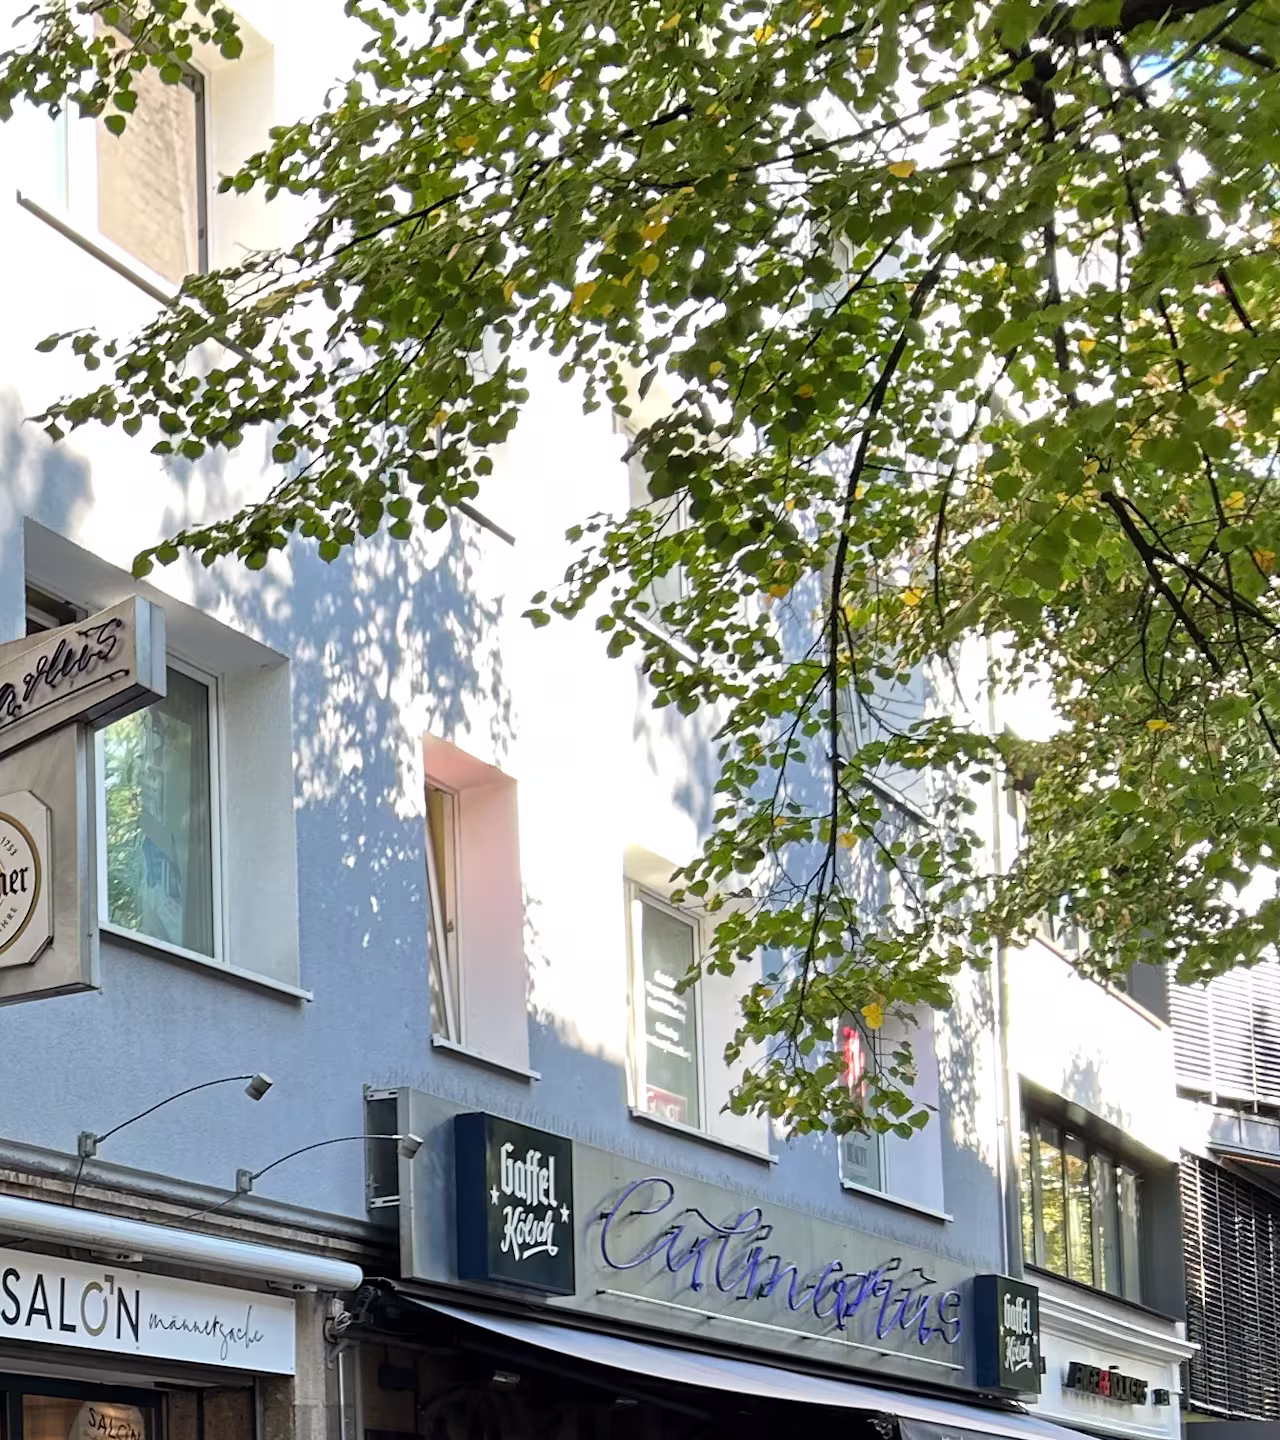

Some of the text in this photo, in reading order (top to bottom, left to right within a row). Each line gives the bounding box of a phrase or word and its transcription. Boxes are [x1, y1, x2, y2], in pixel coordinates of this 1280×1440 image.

[500, 1141, 558, 1208] Gaffel
[500, 1205, 560, 1261] Kölsch
[1003, 1292, 1033, 1336] Gaffel
[1004, 1335, 1033, 1373] Kölsch
